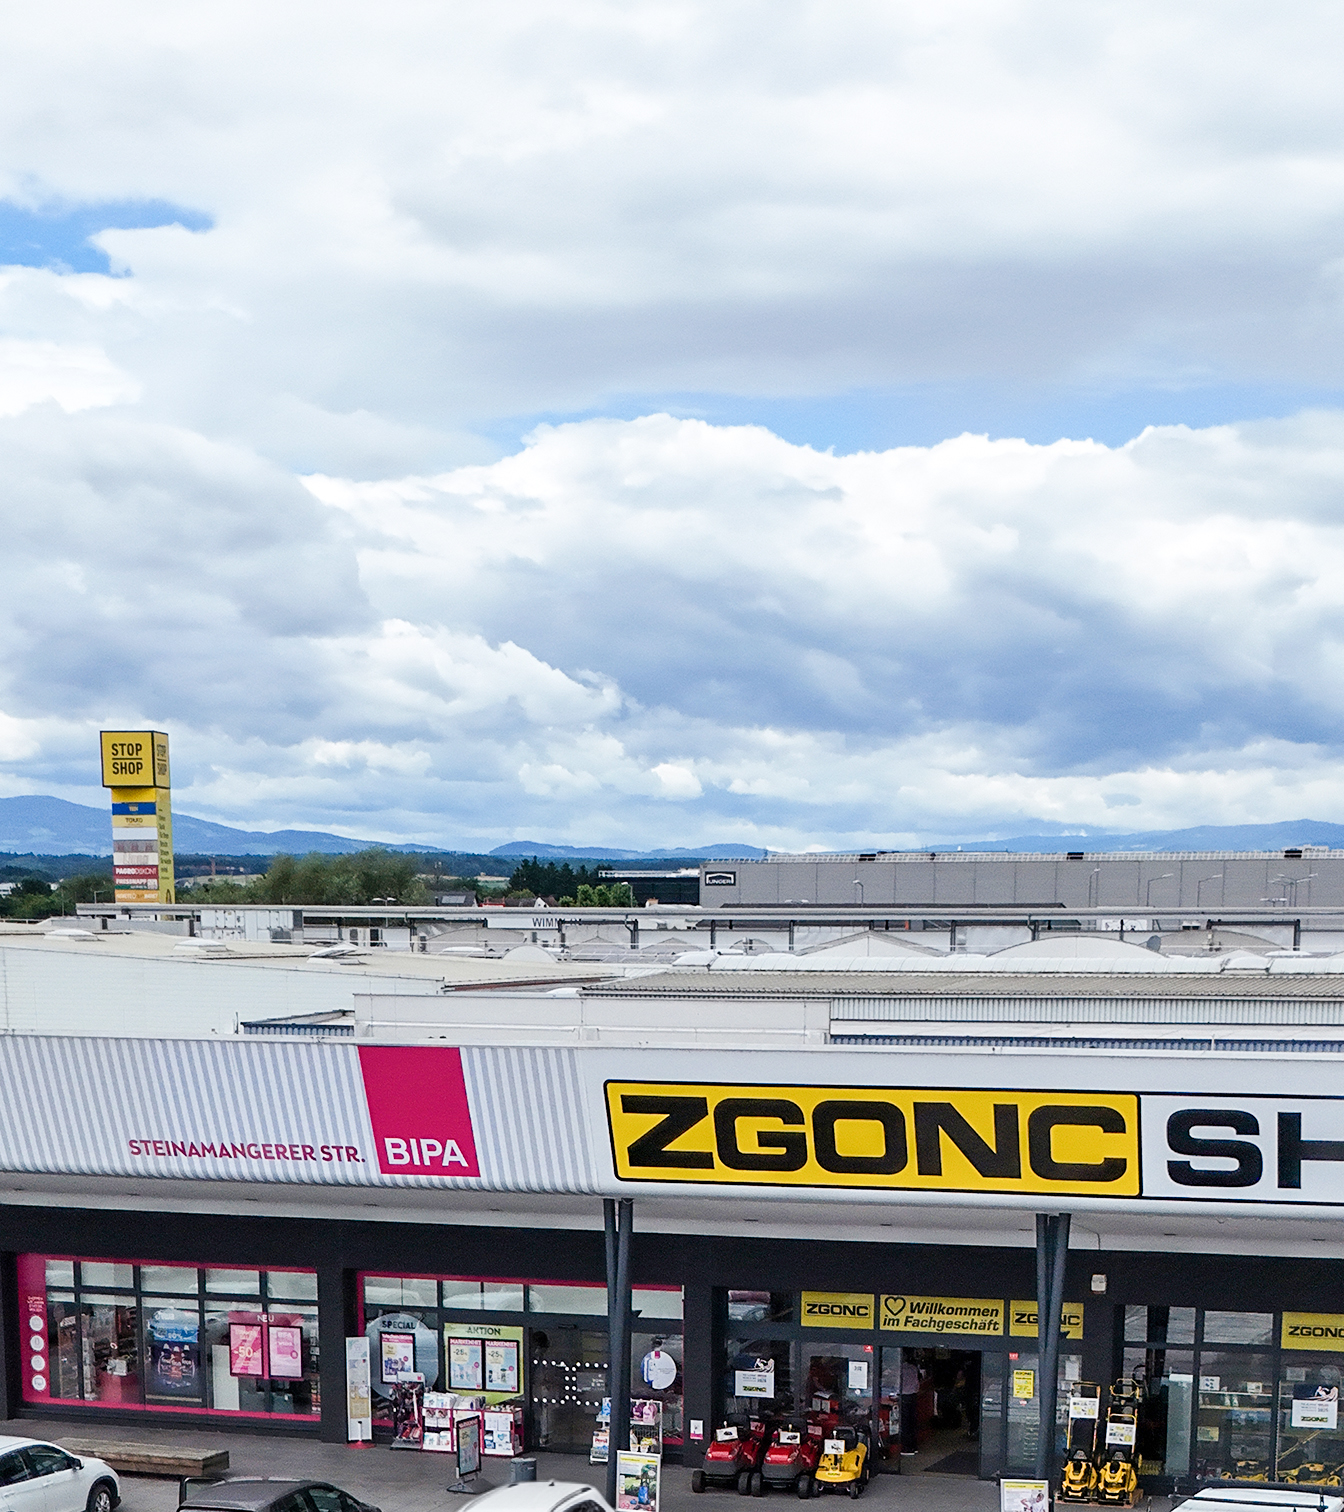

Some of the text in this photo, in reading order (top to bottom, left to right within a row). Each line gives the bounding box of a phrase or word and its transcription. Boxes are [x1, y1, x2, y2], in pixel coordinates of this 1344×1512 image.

[111, 743, 143, 757] STOP
[112, 761, 144, 775] SHOP
[620, 1094, 1127, 1183] ZGONC
[128, 1138, 367, 1164] STEINAMANGERER STR.
[383, 1136, 468, 1168] BIPA
[806, 1302, 869, 1317] ZGONC
[909, 1301, 999, 1317] Willkommen
[256, 1314, 275, 1323] NEU
[381, 1319, 416, 1330] SPECIAL
[882, 1314, 1000, 1332] im Fachgeschäft
[465, 1325, 502, 1336] AKTION
